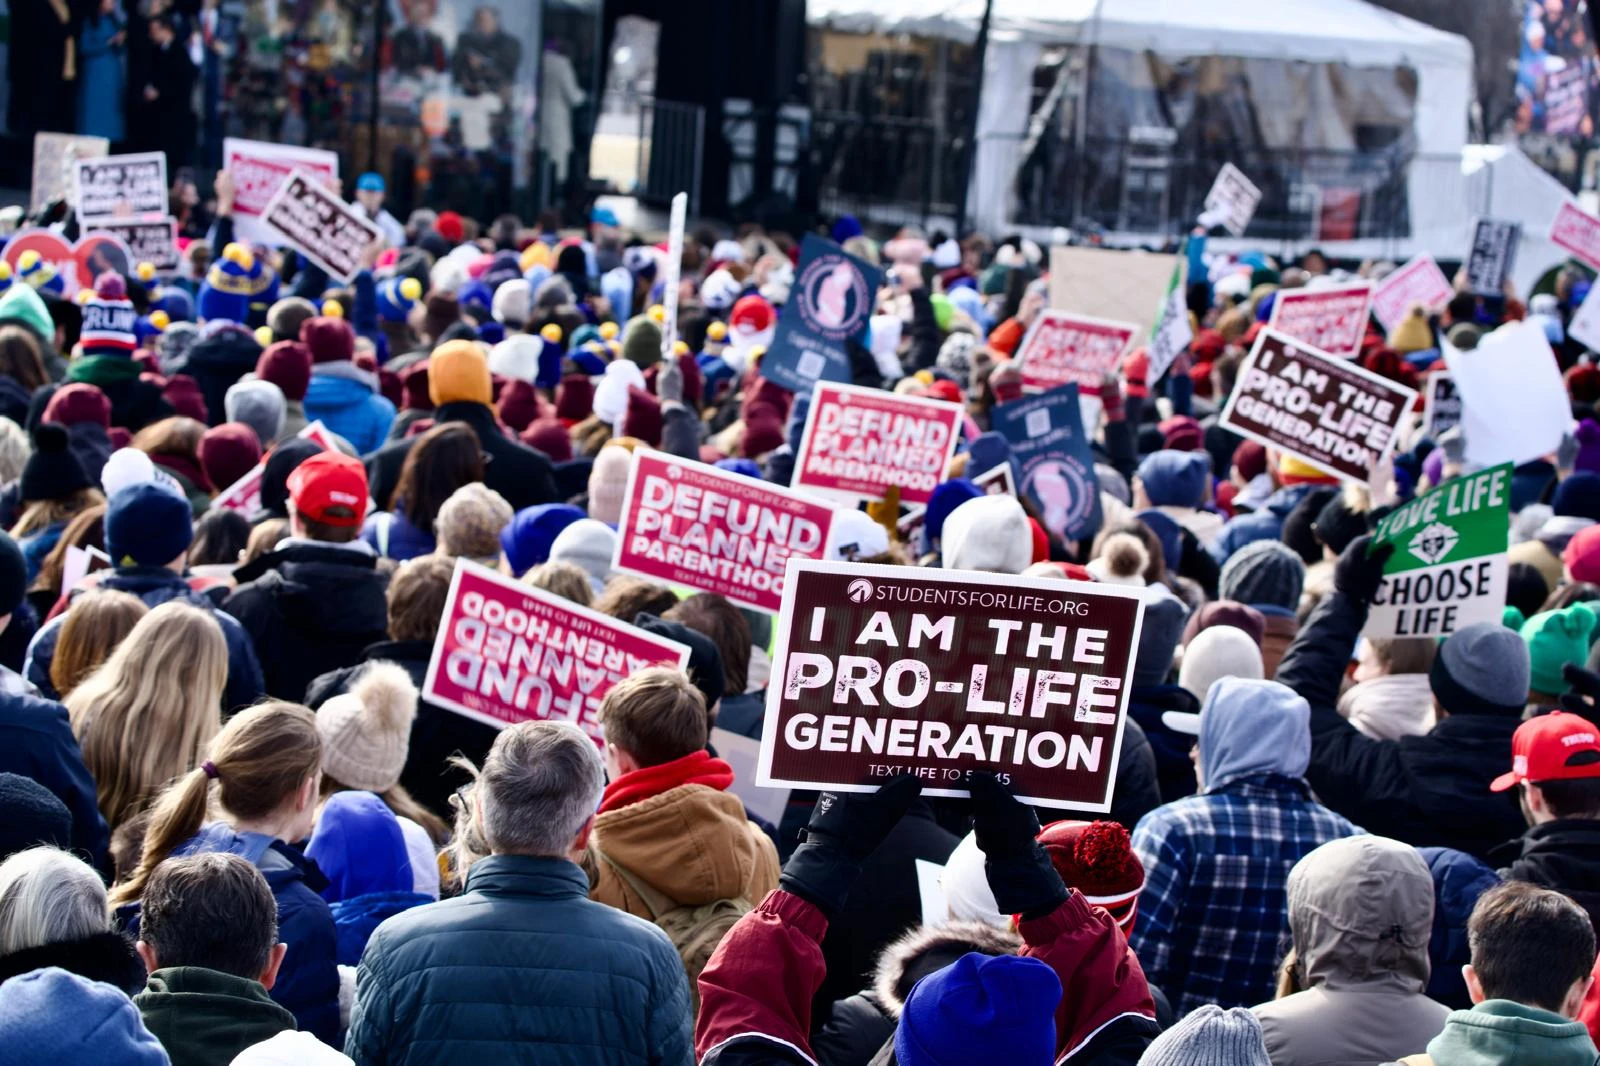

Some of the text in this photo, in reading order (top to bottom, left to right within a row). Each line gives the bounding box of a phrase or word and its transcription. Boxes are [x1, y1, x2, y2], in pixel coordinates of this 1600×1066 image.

[1242, 367, 1393, 451] PRO-LIFE
[1259, 350, 1274, 370] I
[1280, 361, 1329, 394] AM
[1338, 382, 1395, 423] THE
[811, 431, 942, 474] PLANNED
[818, 402, 949, 451] DEFUND
[806, 455, 938, 492] PARENTHOOD
[640, 474, 822, 552] DEFUND
[1375, 469, 1507, 544] LOVE LIFE
[631, 534, 784, 596] PARENTHOO
[635, 507, 812, 574] PLANNE
[875, 585, 1090, 617] STUDENTSFORLIFE.ORG
[1371, 562, 1491, 606] CHOOSE
[462, 590, 650, 673] ARENTHOOD
[809, 606, 1109, 665] I AM THE
[1395, 606, 1458, 635] LIFE
[446, 649, 603, 736] EFUND
[784, 652, 1122, 725] PRO-LIFE
[784, 713, 1104, 773] GENERATION
[868, 764, 903, 777] TEXT
[942, 768, 961, 781] TO
